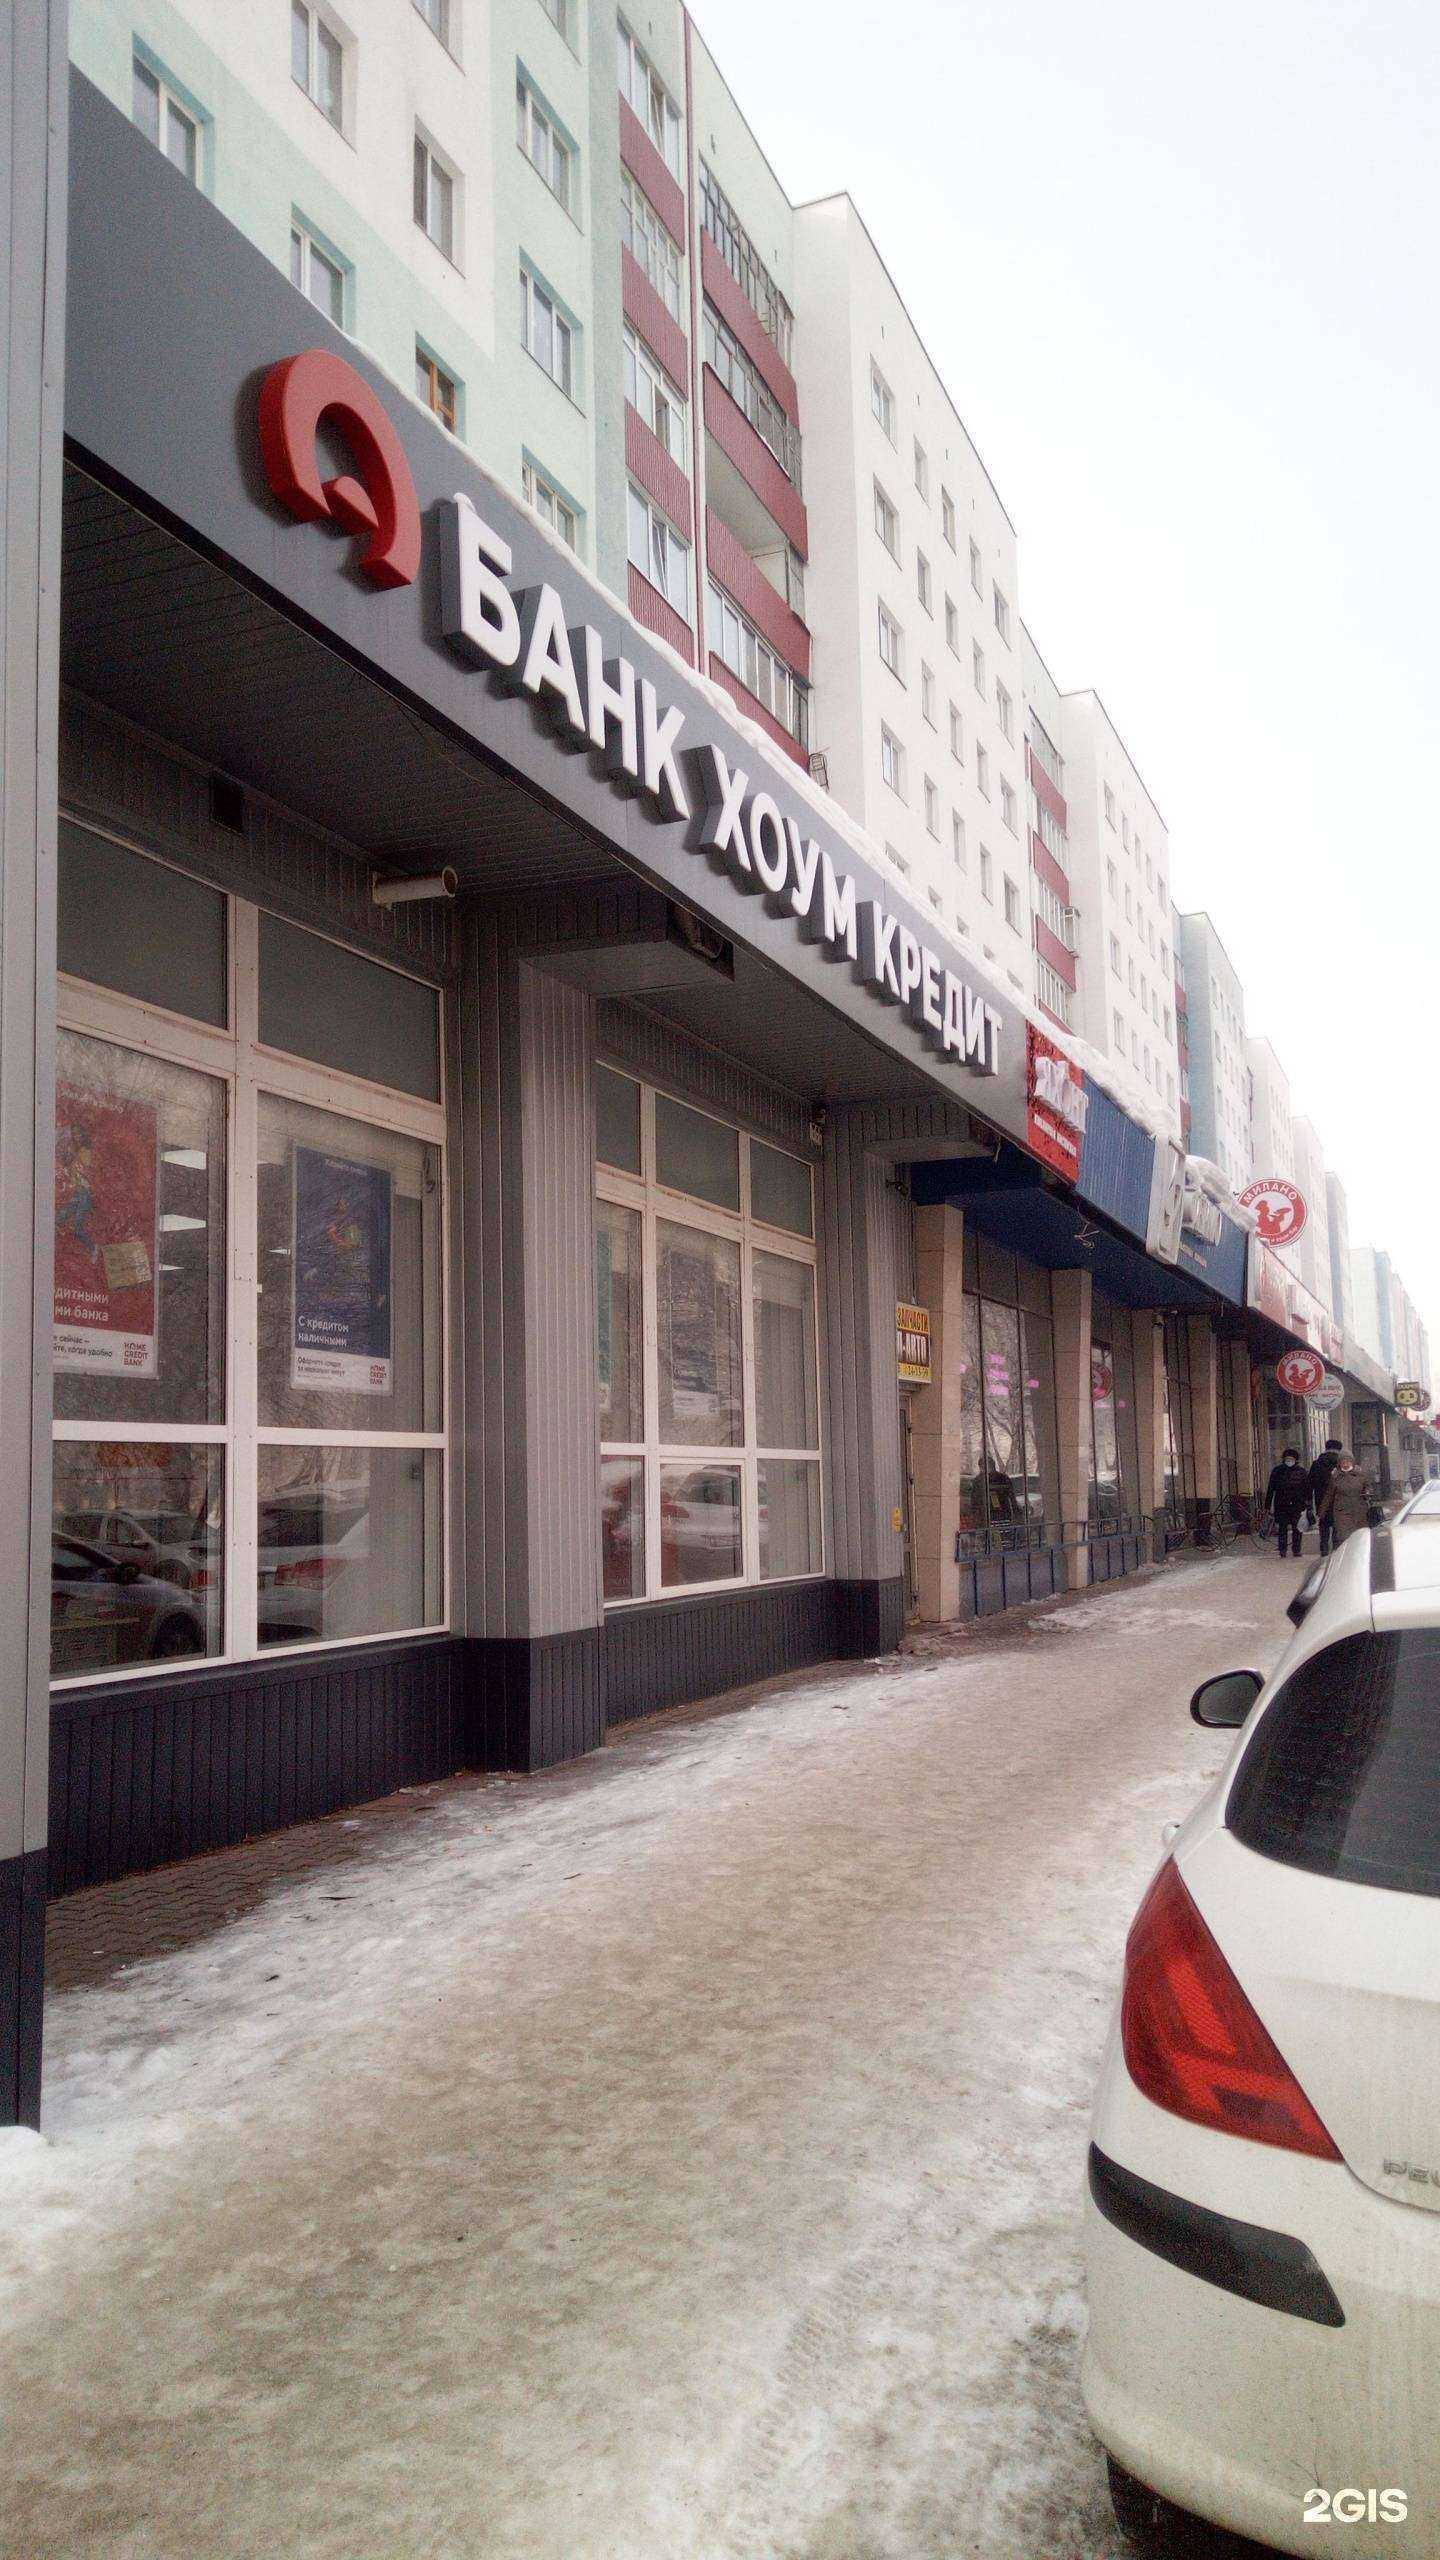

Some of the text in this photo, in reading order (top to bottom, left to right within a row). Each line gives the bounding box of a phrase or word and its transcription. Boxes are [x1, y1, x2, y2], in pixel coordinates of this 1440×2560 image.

[457, 499, 1002, 1076] БАНК ХОУМ КРЕДИТ
[1243, 1181, 1299, 1205] МИЛАНО
[73, 1305, 109, 1322] банка
[298, 1315, 350, 1333] С кредитом
[298, 1333, 348, 1348] наличными
